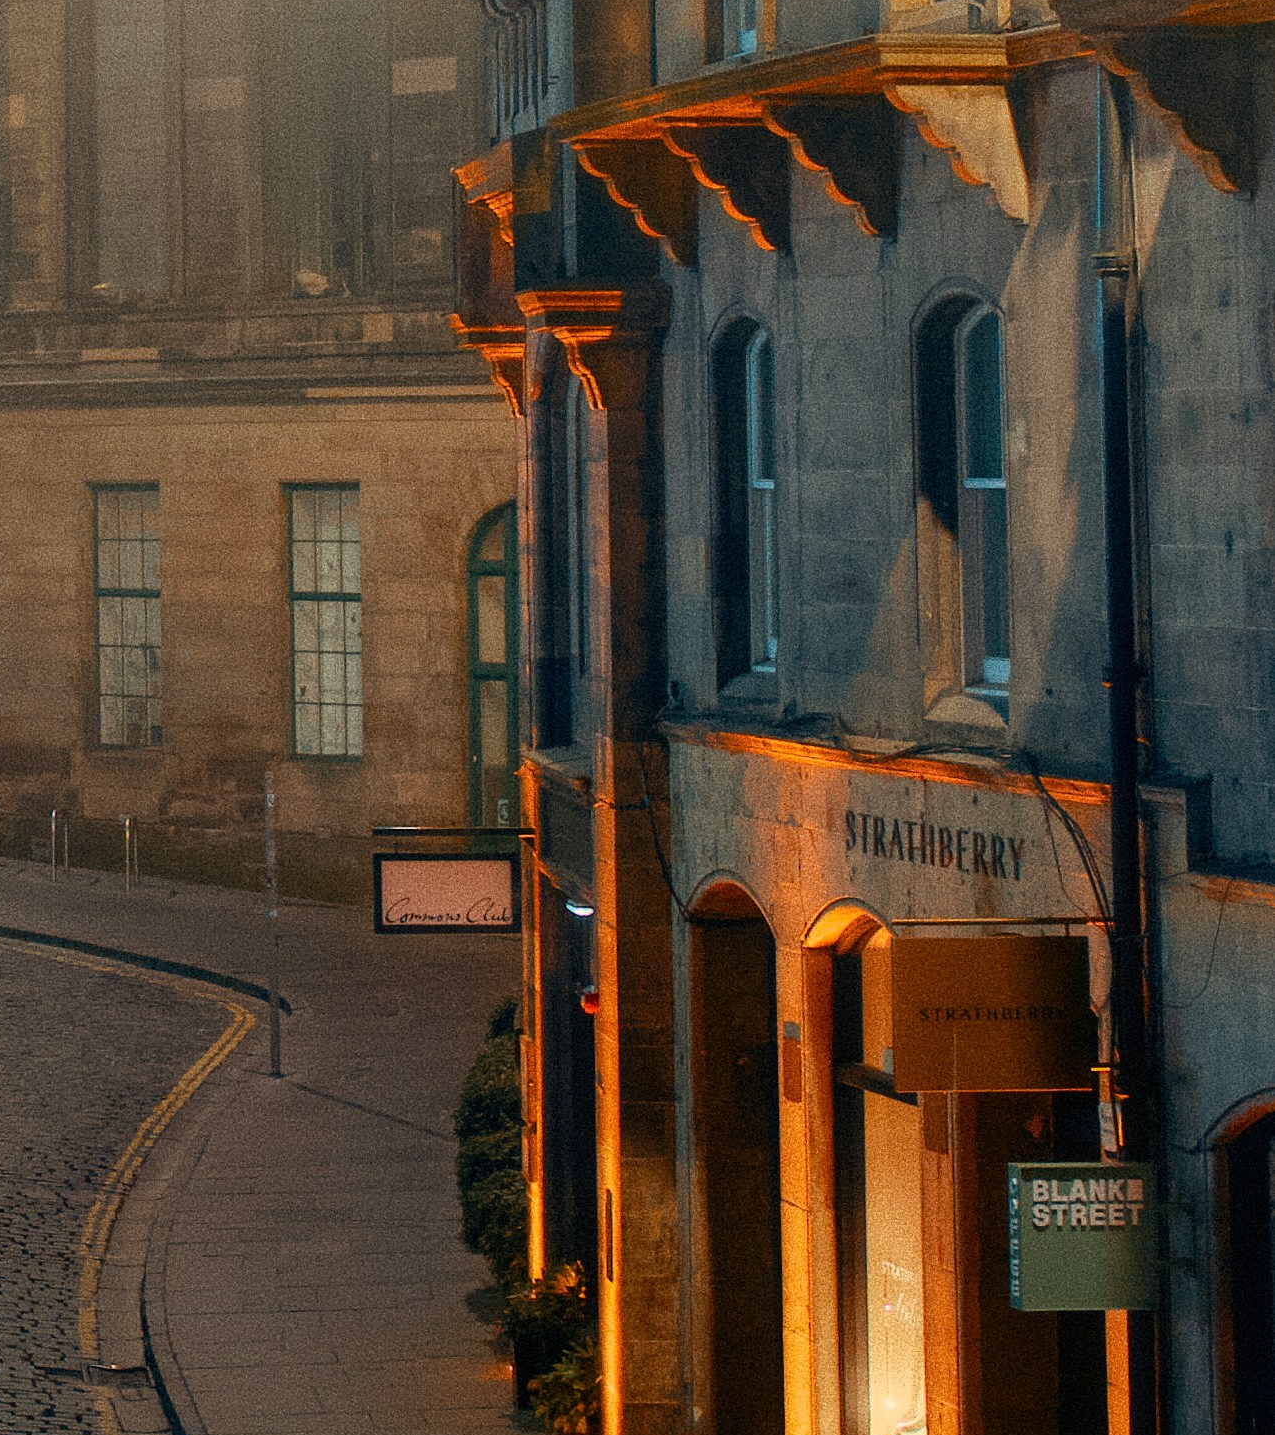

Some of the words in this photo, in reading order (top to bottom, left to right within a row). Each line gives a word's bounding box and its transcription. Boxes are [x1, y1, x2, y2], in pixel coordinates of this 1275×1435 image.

[844, 808, 1026, 881] STRATHBERRY
[385, 896, 462, 925] Commons
[465, 896, 513, 925] Club
[918, 1004, 1065, 1024] STRATHBERRY
[1032, 1178, 1126, 1202] BLANK
[1032, 1203, 1144, 1228] STREET
